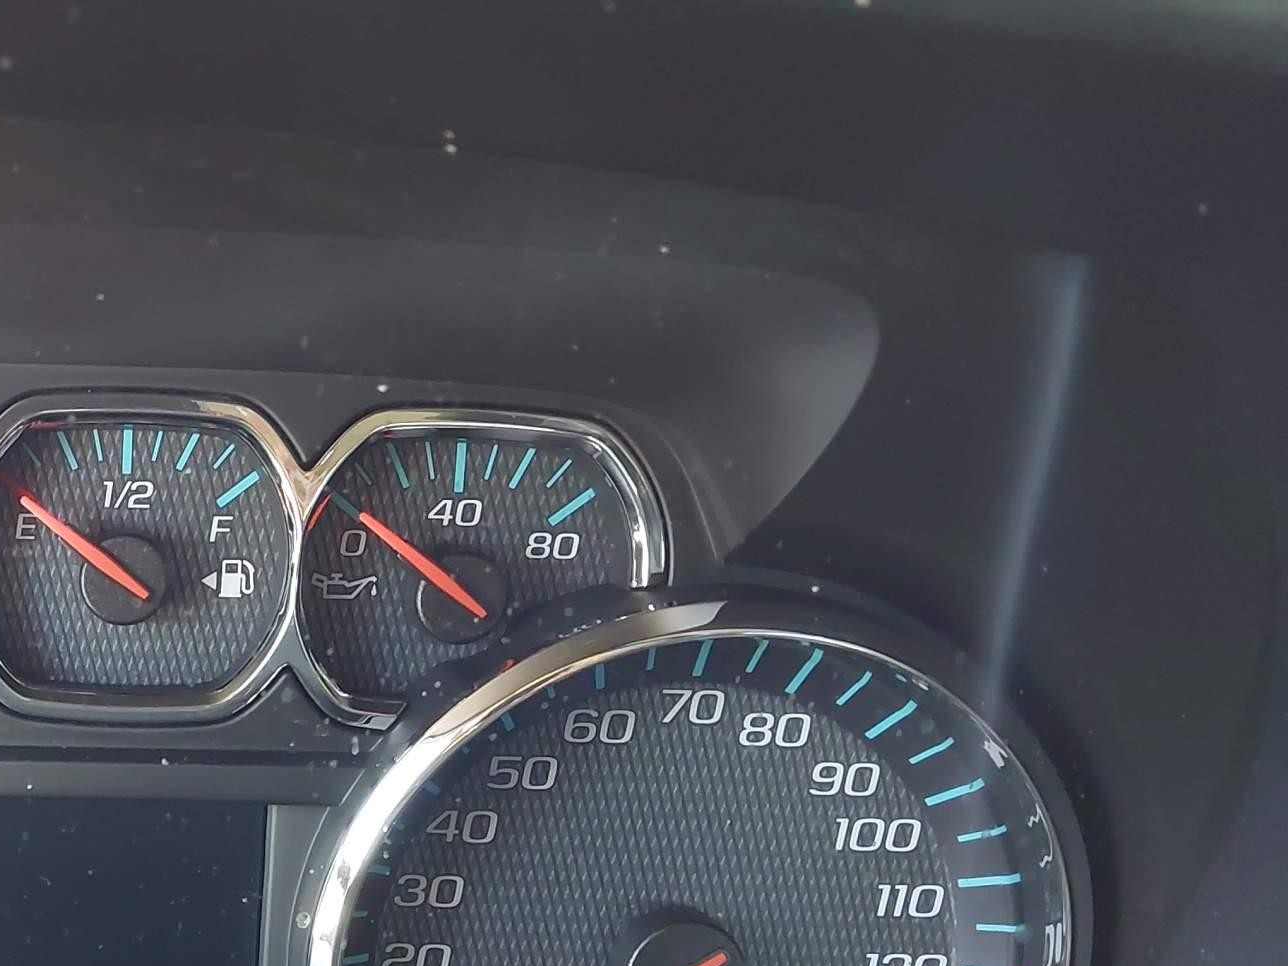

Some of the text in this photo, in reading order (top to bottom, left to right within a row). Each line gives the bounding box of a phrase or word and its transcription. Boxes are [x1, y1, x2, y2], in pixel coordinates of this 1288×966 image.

[103, 481, 153, 509] 1/2
[15, 514, 37, 541] E
[210, 516, 233, 542] F
[428, 499, 482, 527] 40
[340, 530, 367, 557] 0
[525, 533, 580, 559] 80
[661, 689, 725, 724] 70
[563, 710, 636, 745] 60
[739, 713, 812, 747] 80
[487, 756, 559, 791] 50
[809, 762, 880, 796] 90
[426, 810, 498, 844] 40
[835, 818, 922, 853] 100
[394, 876, 463, 908] 30
[876, 884, 945, 918] 110
